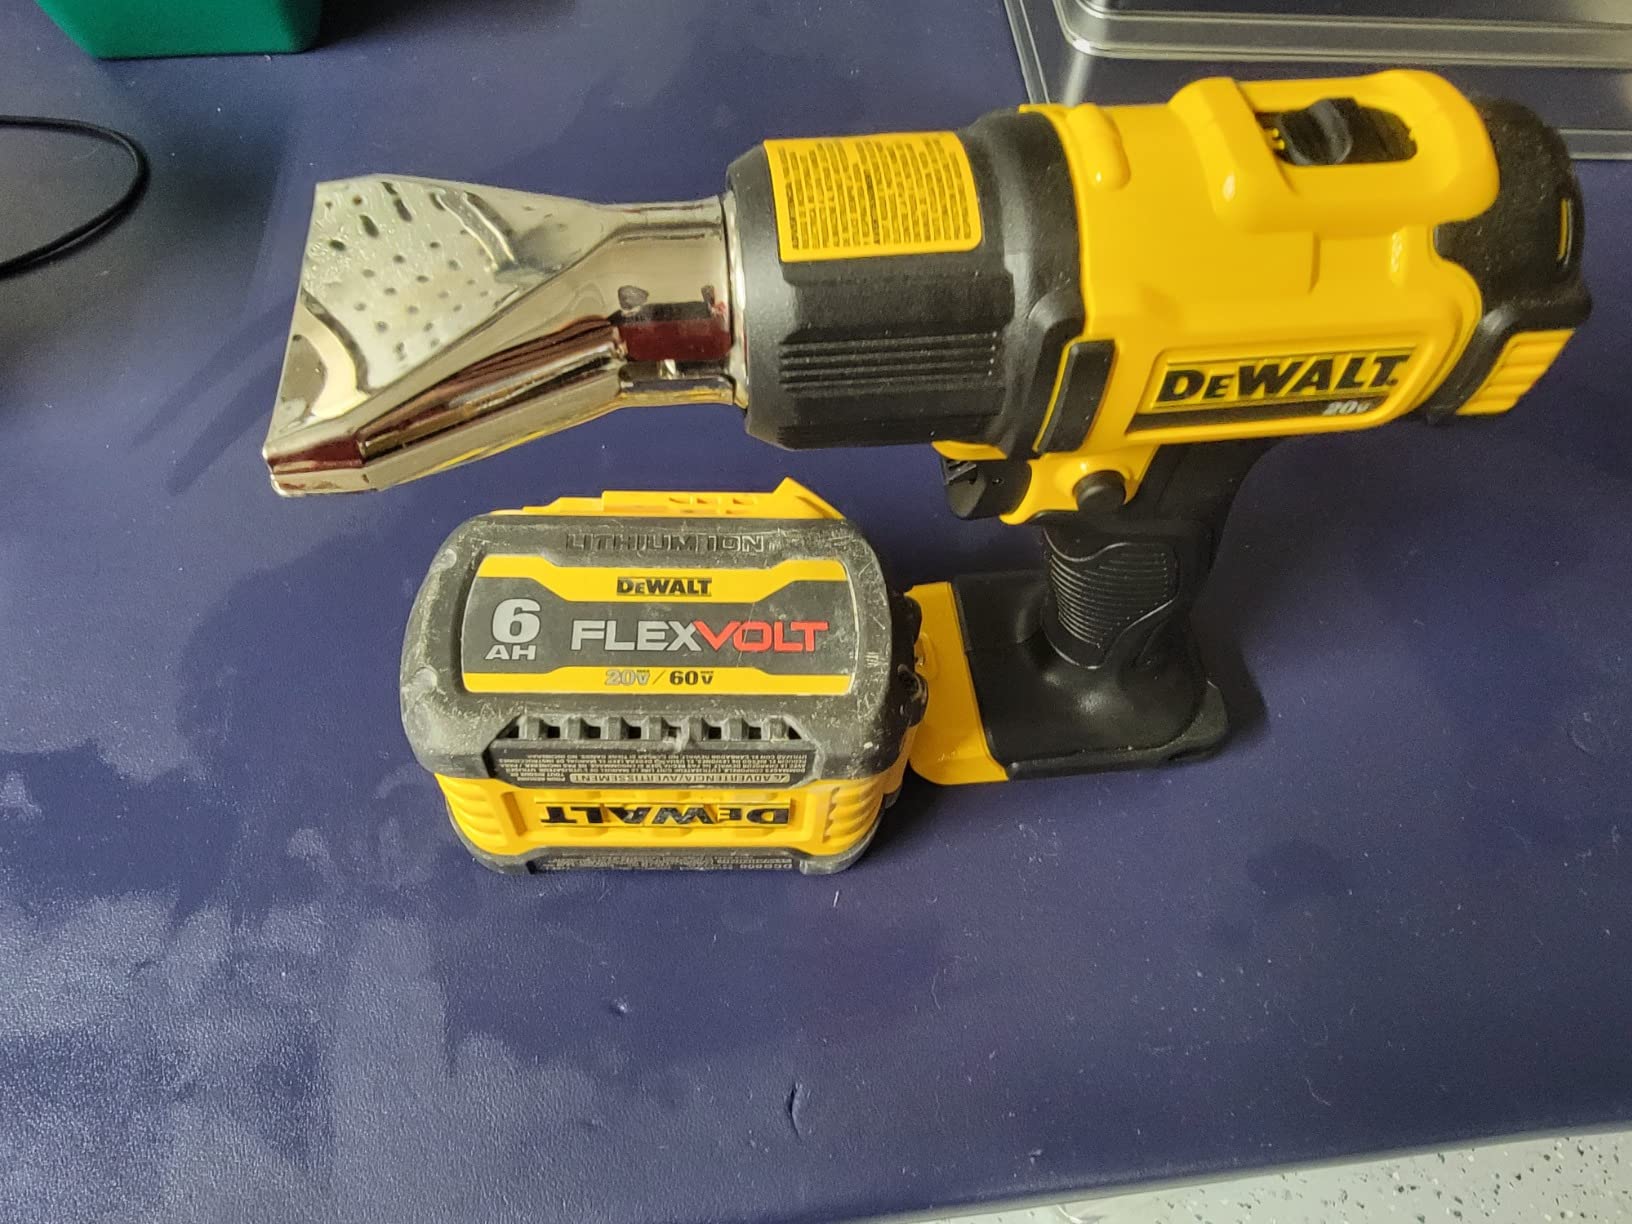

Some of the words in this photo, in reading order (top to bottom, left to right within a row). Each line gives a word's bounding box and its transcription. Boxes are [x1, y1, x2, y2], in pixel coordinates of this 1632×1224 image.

[565, 534, 699, 550] LITHIUM
[706, 535, 764, 551] ION
[491, 598, 541, 644] 6
[570, 620, 829, 653] FLEXVOLT
[484, 644, 537, 661] AH
